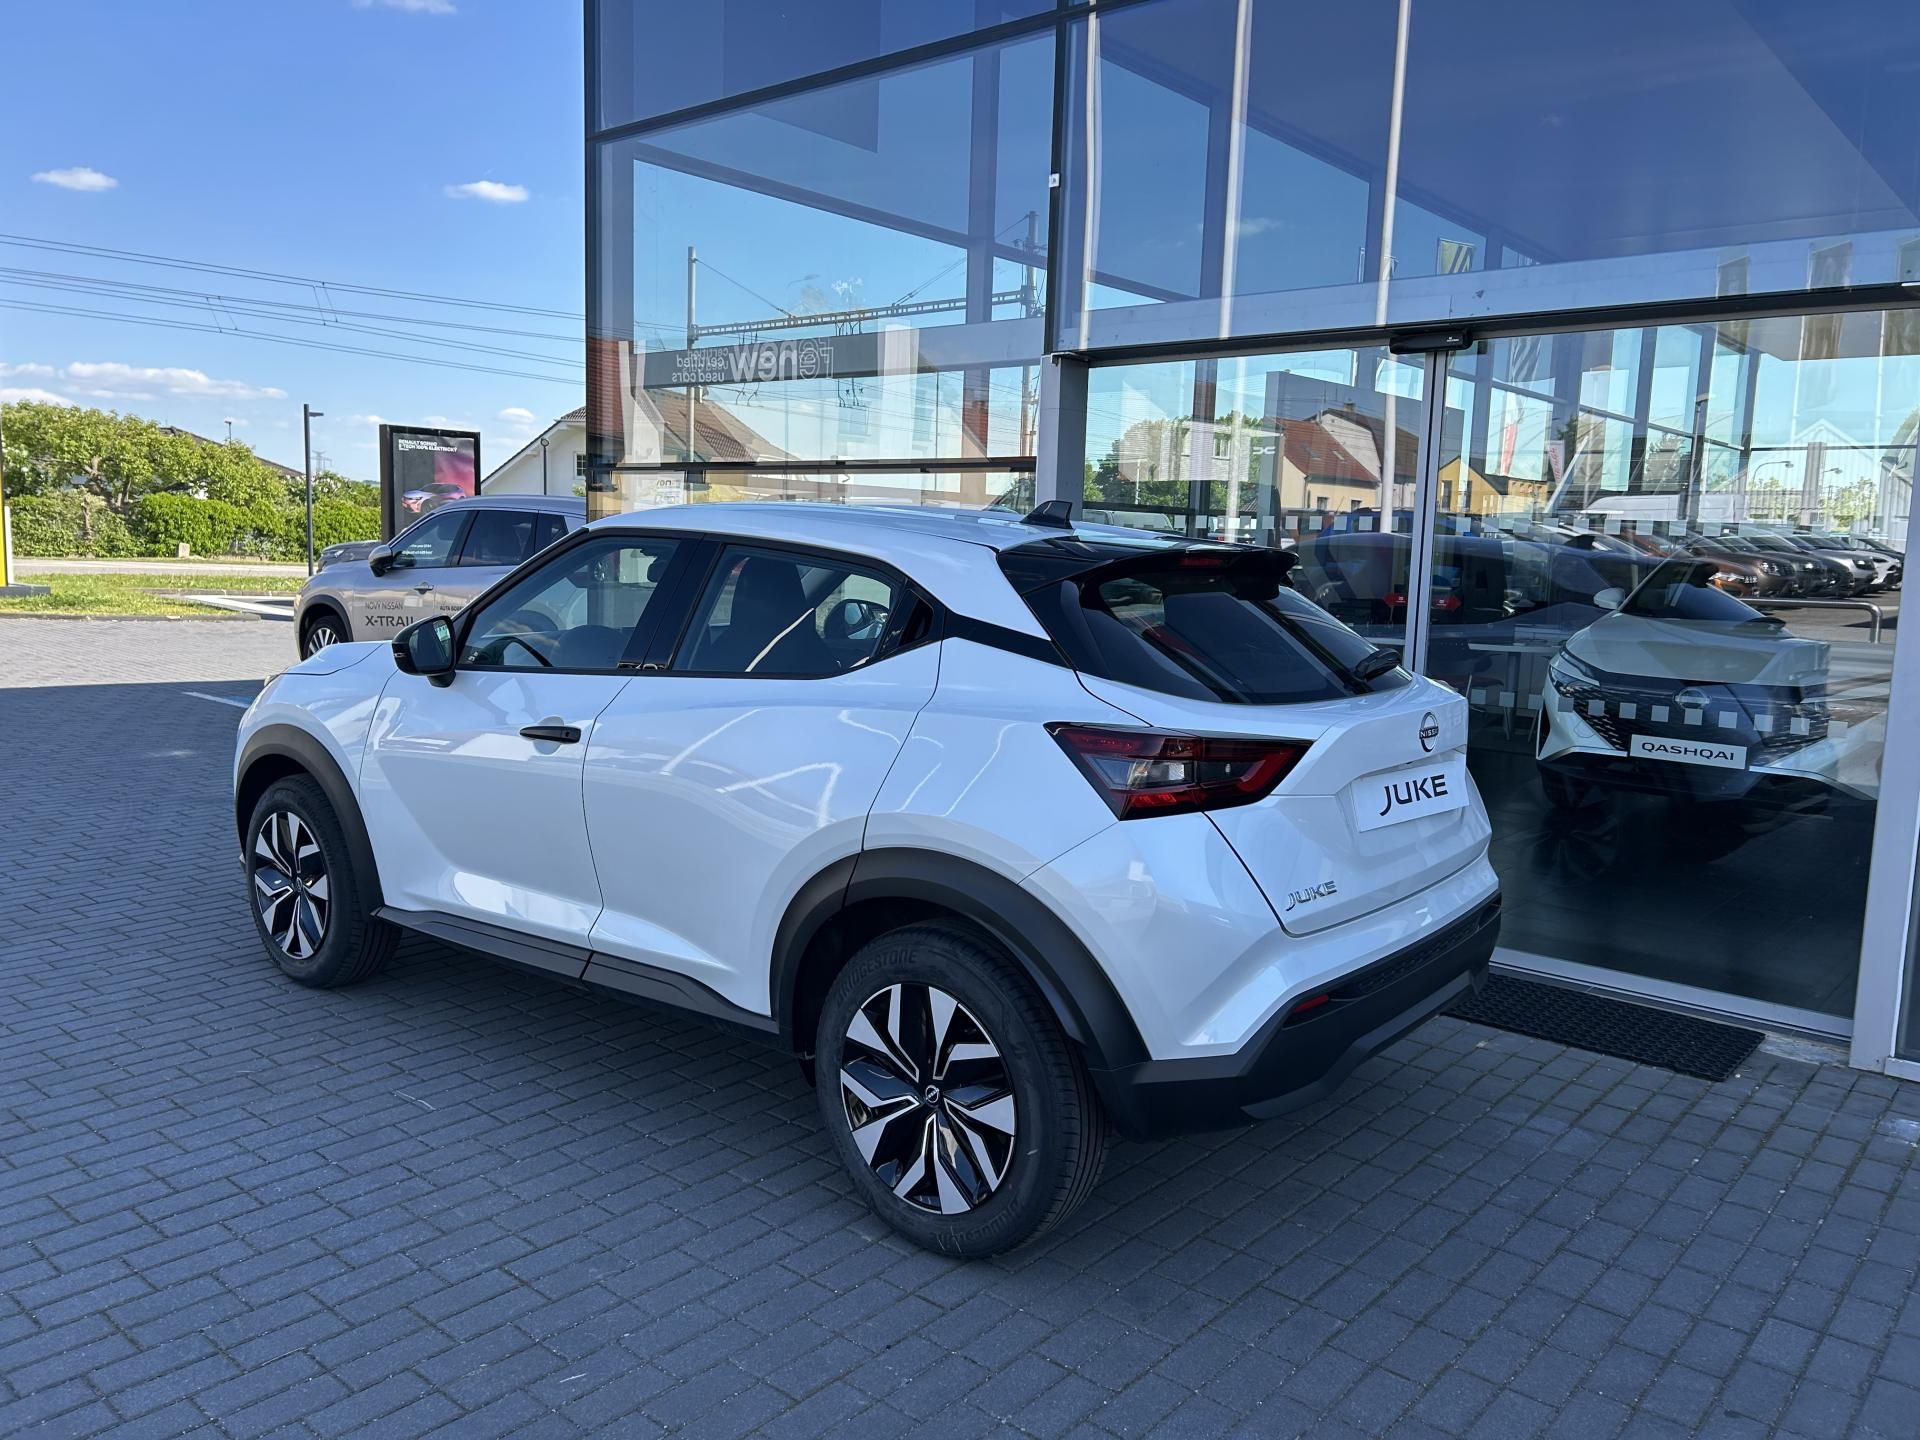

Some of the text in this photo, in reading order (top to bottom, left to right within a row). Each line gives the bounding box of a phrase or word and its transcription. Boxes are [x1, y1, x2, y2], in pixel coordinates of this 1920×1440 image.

[382, 600, 404, 610] NISSAN
[1641, 742, 1735, 761] QASHQAI
[1379, 774, 1449, 816] JUKE
[1285, 880, 1338, 912] JUKE
